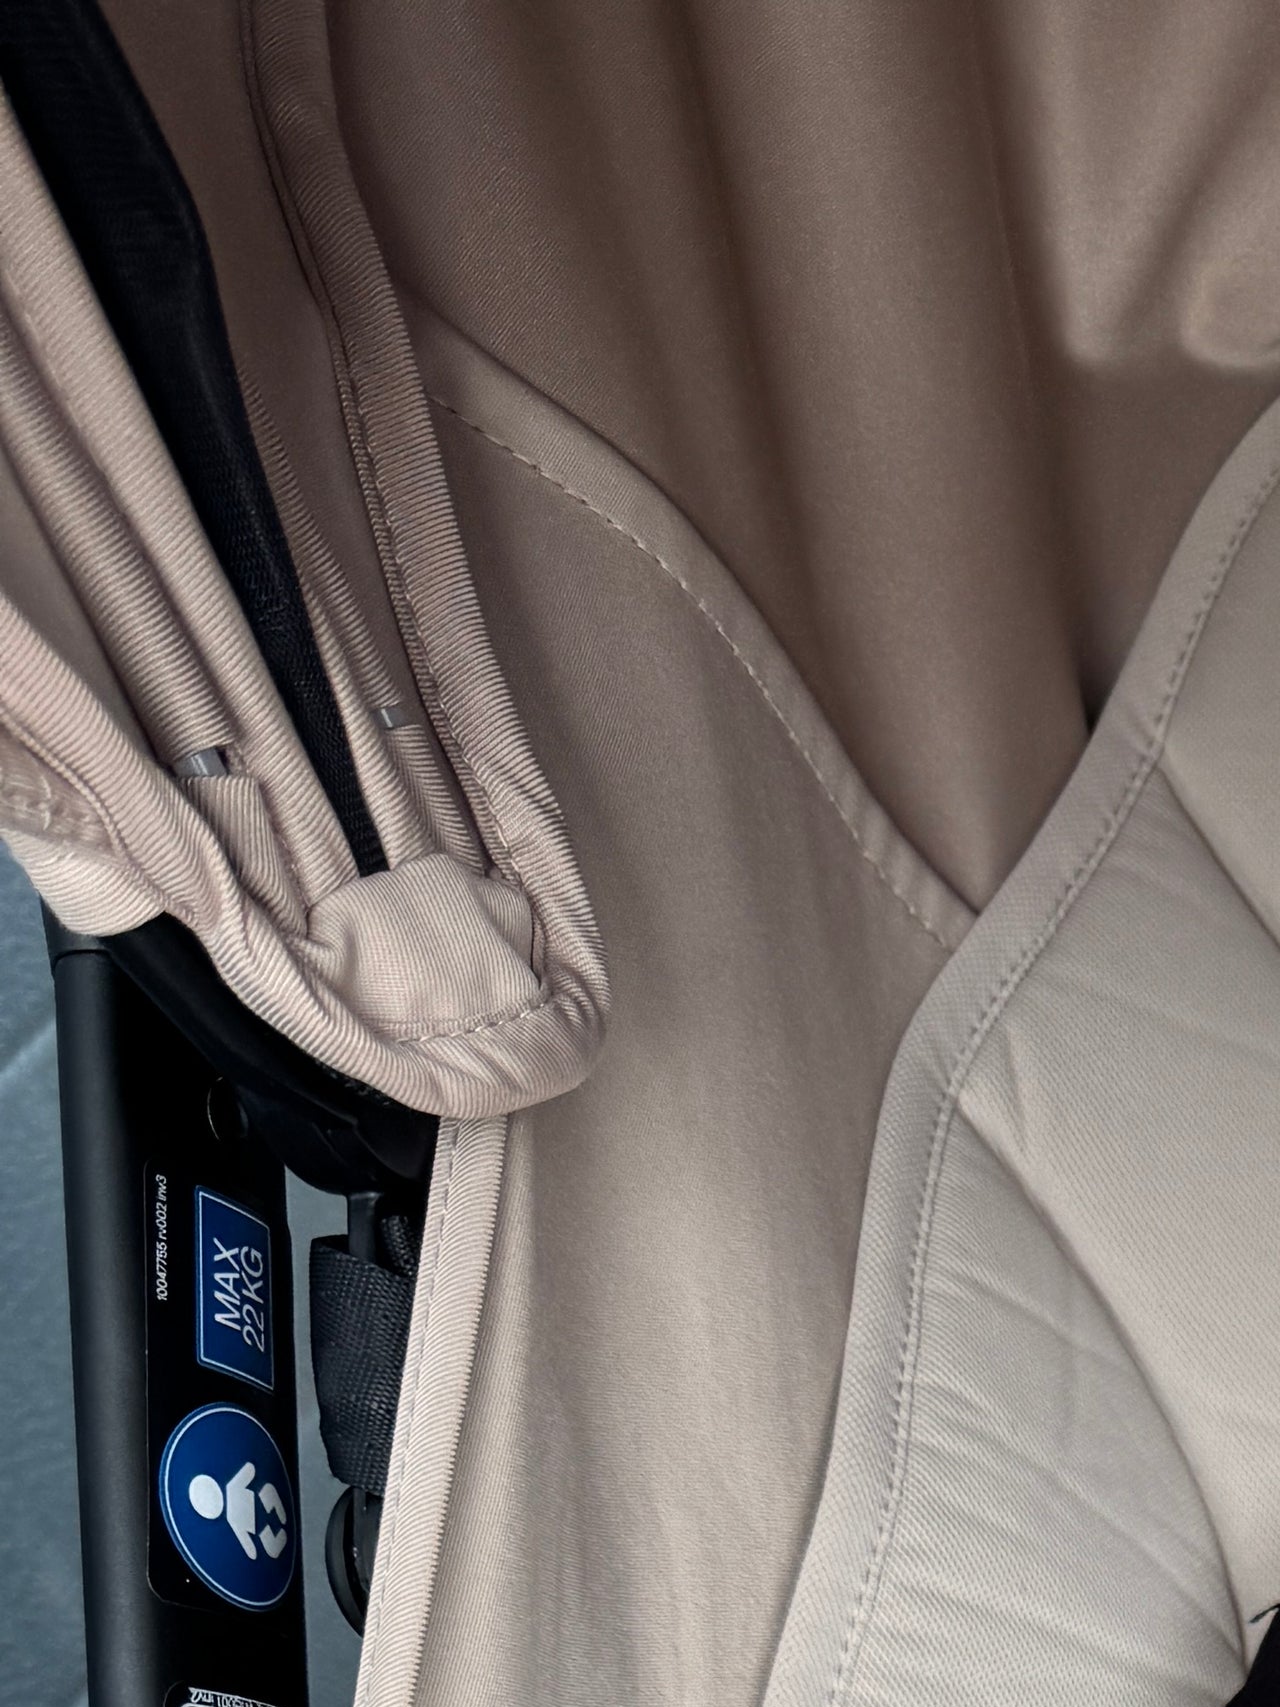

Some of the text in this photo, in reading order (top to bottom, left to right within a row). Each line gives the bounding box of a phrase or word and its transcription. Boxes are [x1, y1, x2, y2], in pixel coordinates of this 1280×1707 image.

[155, 1201, 167, 1241] rv002
[156, 1242, 168, 1301] 10047755
[213, 1237, 241, 1331] MAX
